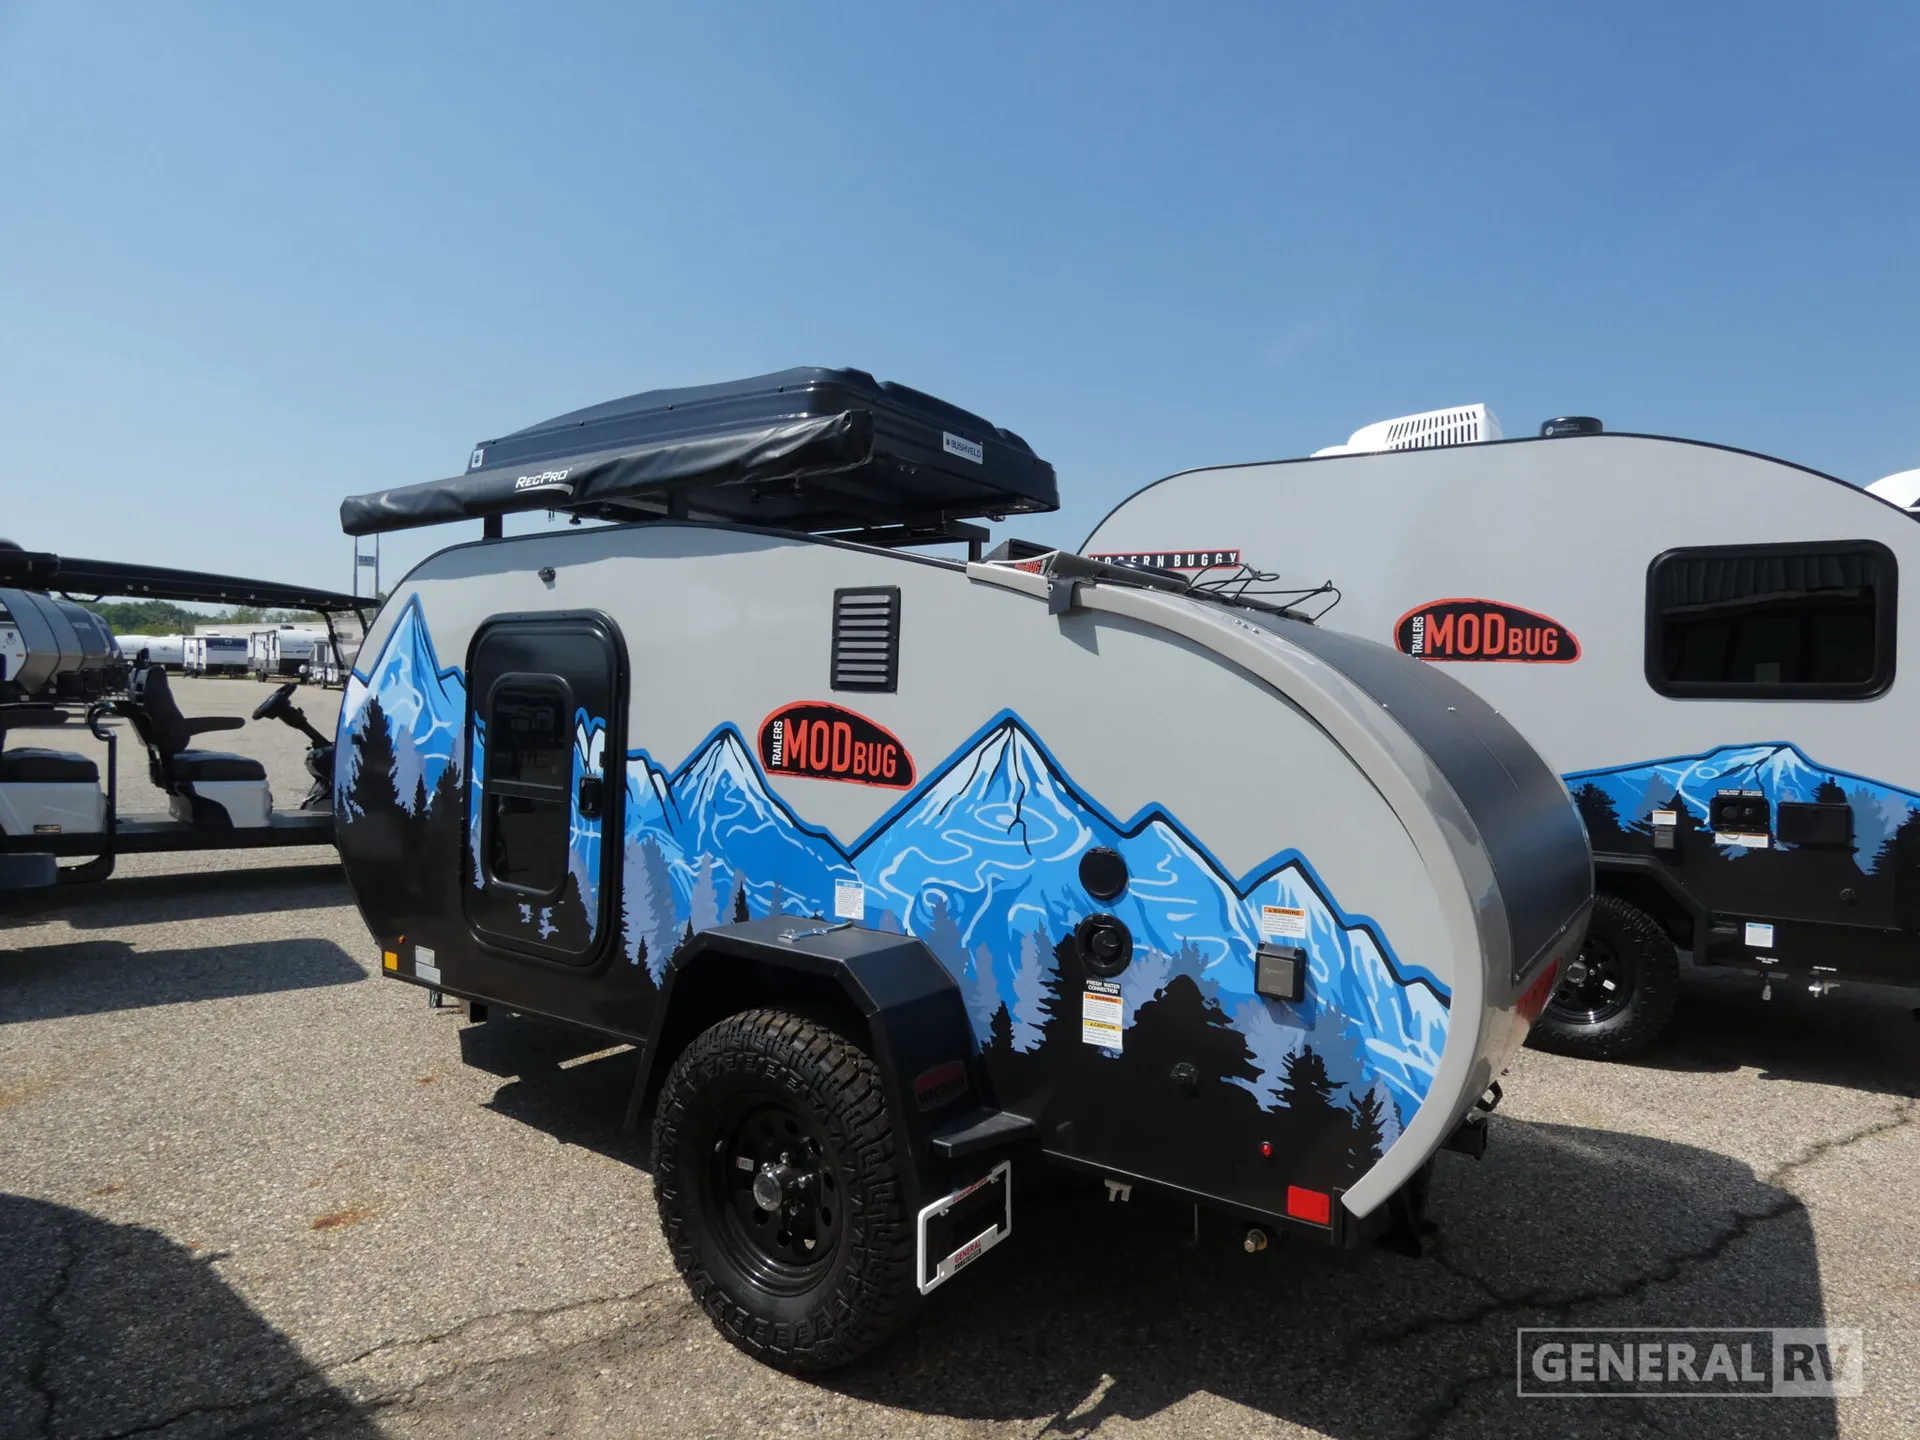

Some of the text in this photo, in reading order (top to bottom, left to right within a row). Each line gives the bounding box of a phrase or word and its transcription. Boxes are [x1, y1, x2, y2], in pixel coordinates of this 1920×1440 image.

[1174, 552, 1237, 567] BUGGY
[1412, 616, 1424, 654] TRAILERS
[772, 721, 783, 766] TRAILERS
